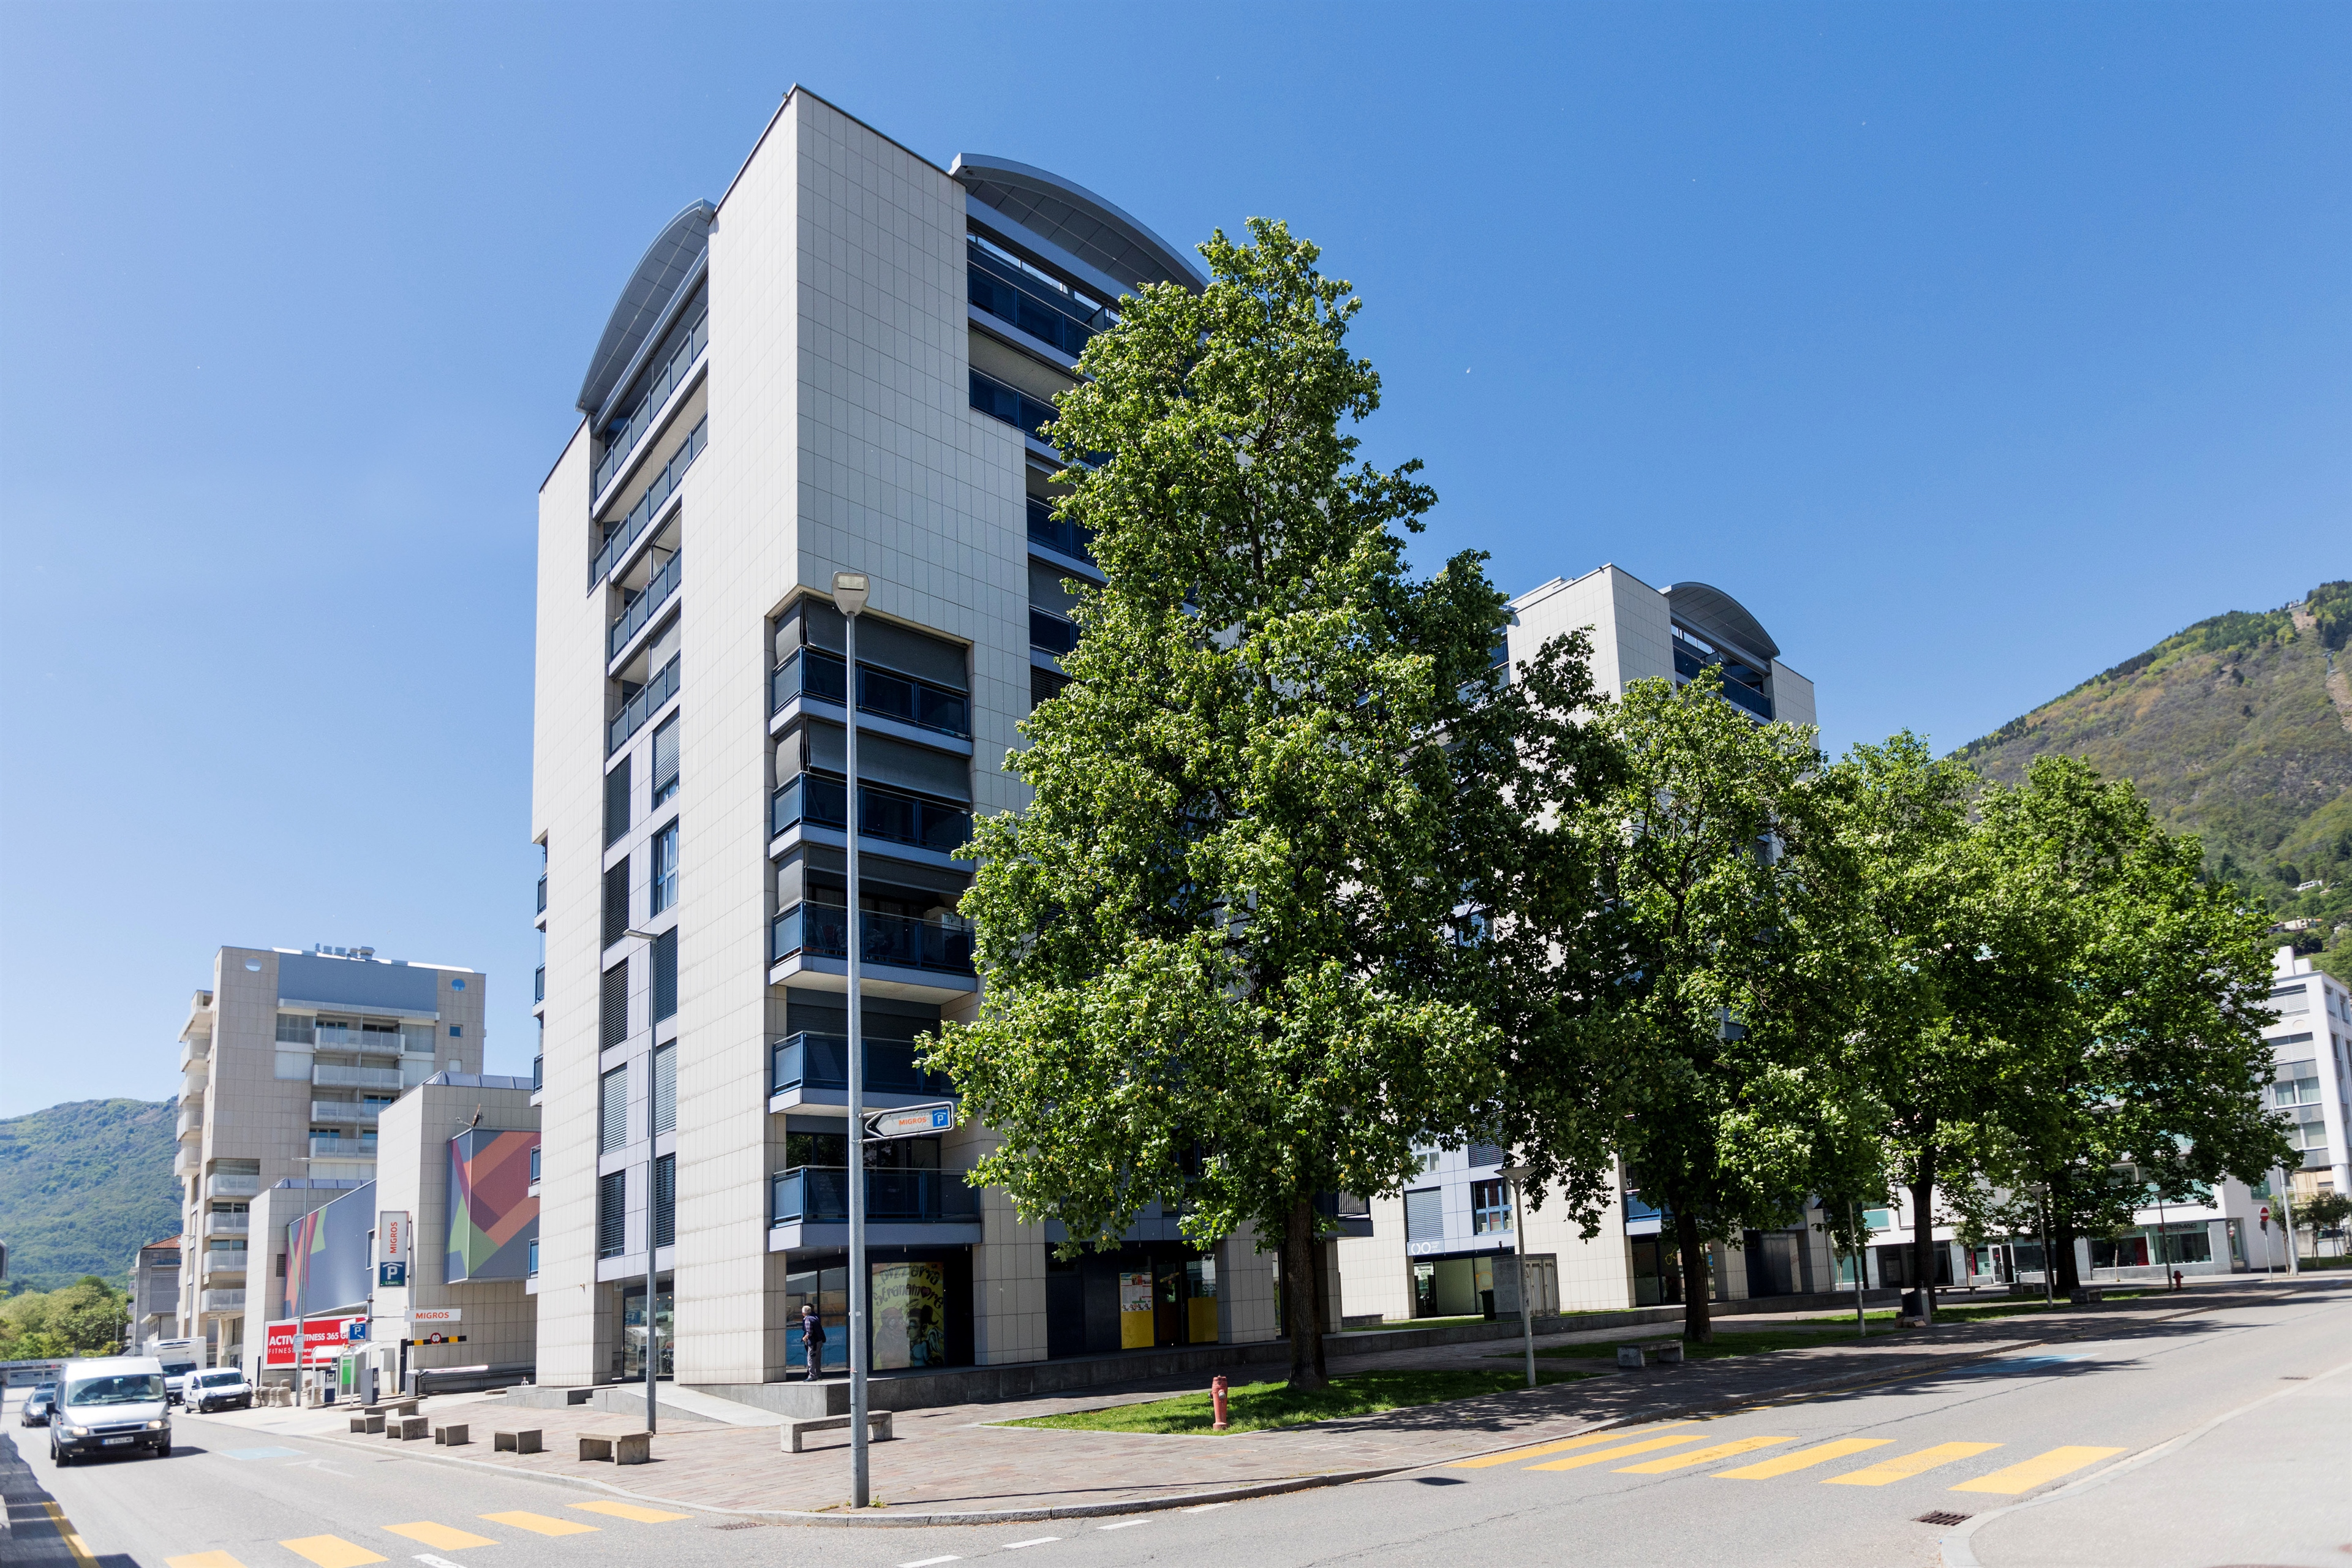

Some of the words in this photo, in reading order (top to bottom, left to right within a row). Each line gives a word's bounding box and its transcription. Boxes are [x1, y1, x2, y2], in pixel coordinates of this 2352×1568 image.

[899, 1117, 927, 1126] MIGROS
[937, 1114, 944, 1125] P
[390, 1221, 398, 1254] MIGROS
[387, 1266, 398, 1280] P
[880, 1263, 941, 1286] pizzeria
[355, 1326, 361, 1335] P
[326, 1332, 339, 1341] 365
